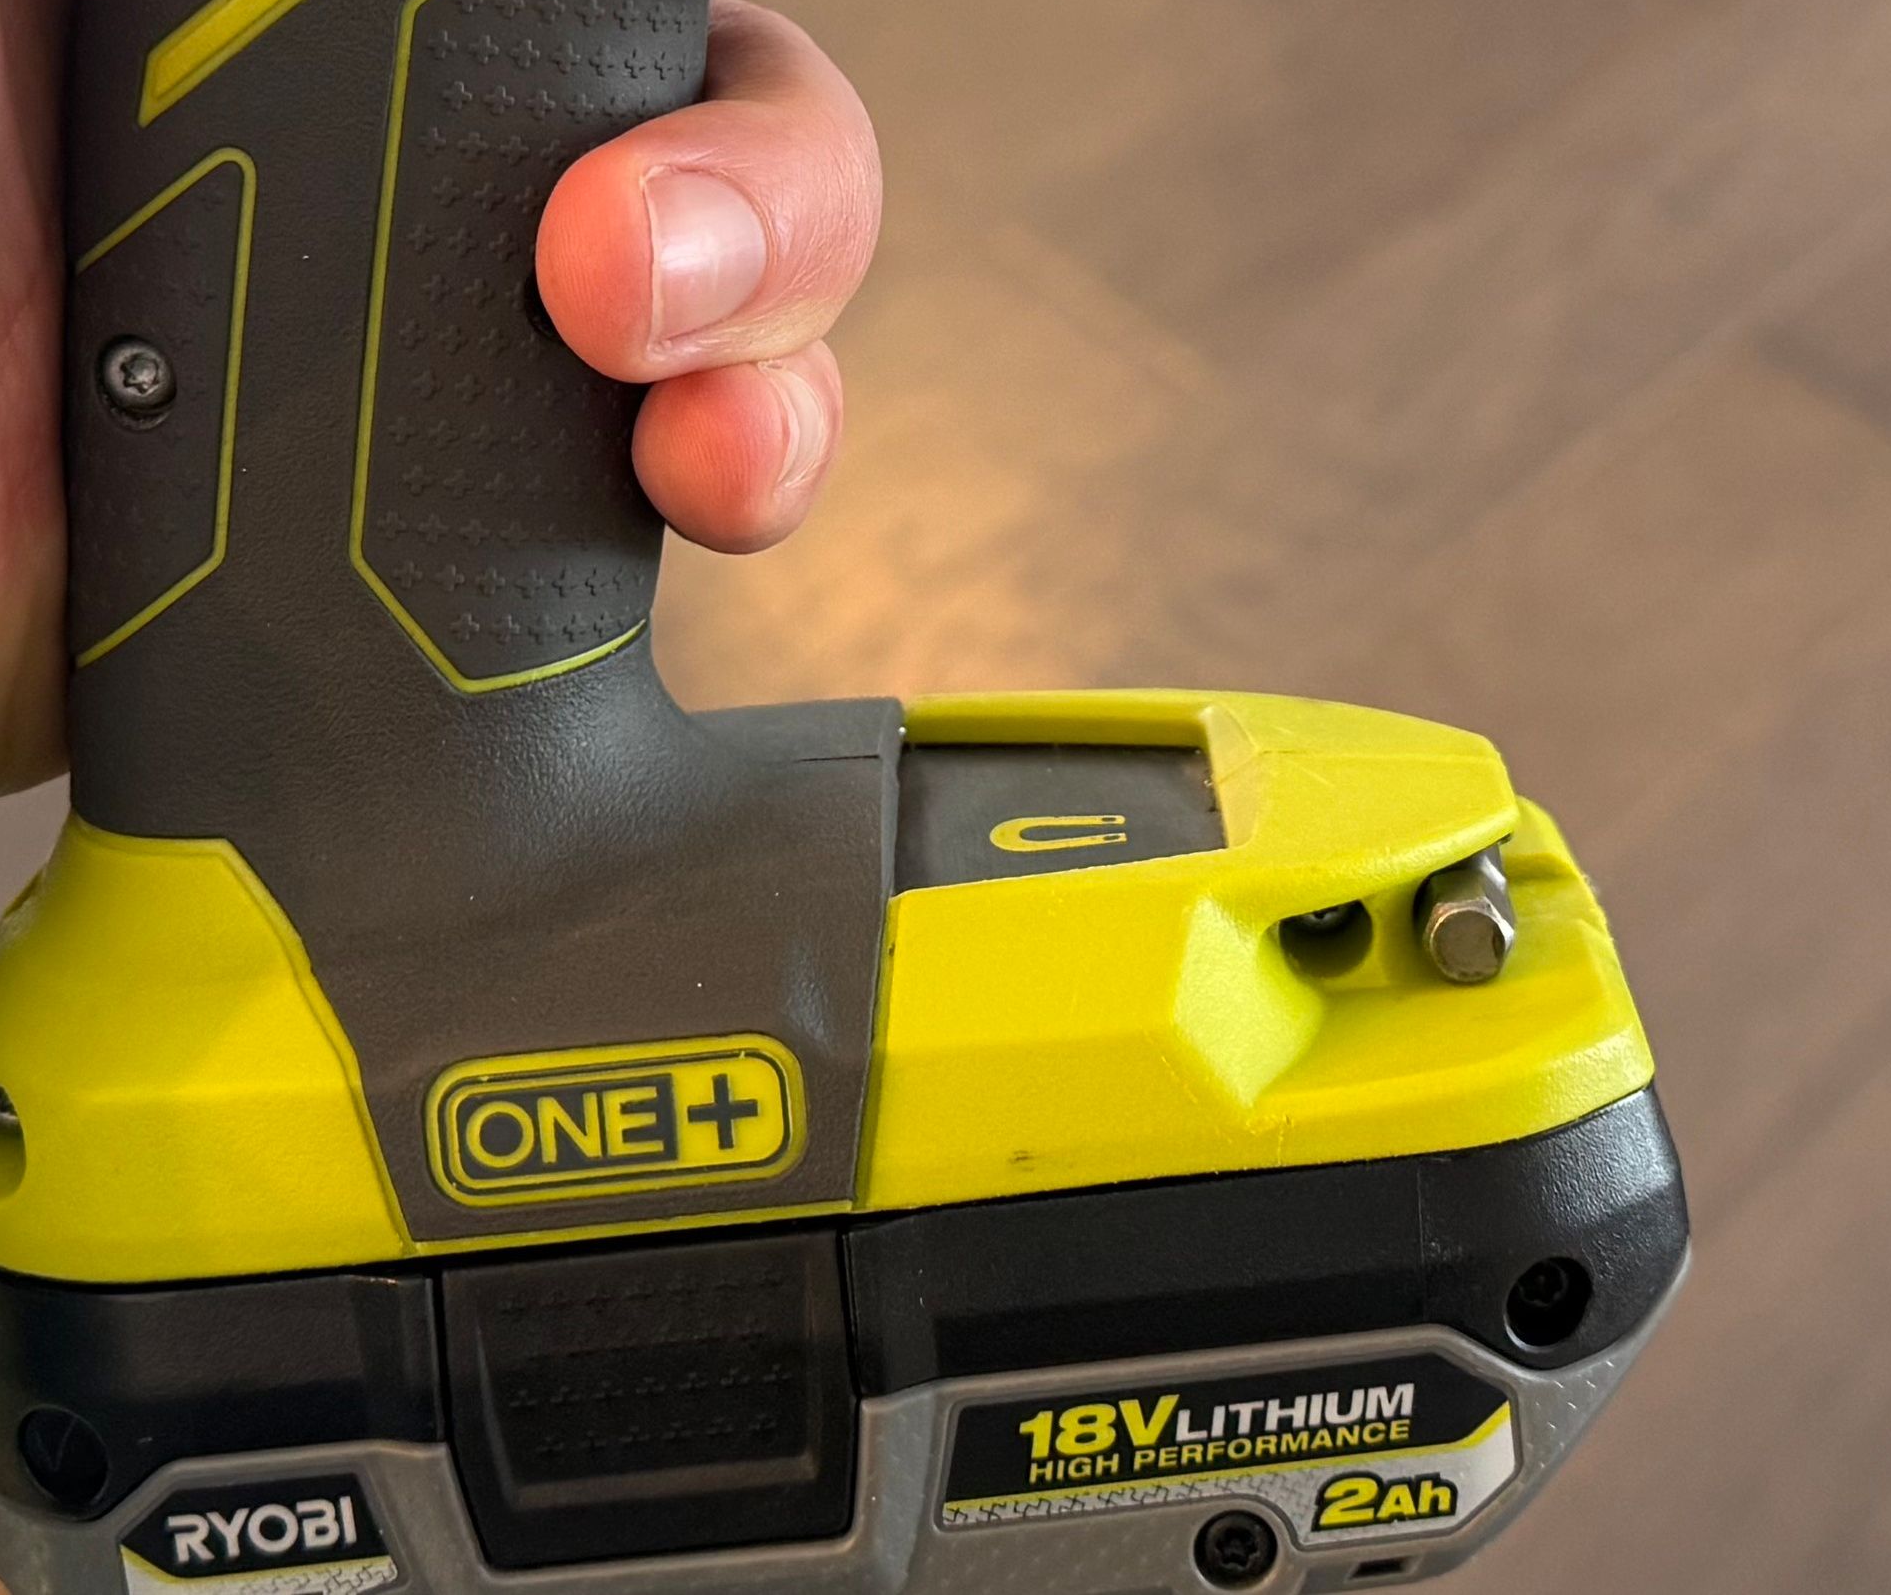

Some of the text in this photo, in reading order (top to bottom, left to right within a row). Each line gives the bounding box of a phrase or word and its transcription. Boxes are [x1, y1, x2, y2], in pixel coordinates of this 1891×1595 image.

[1019, 1383, 1415, 1460] 18V LITHIUM
[1029, 1418, 1411, 1485] HIGH PERFORMANCE
[167, 1495, 357, 1564] RYOBI
[1318, 1475, 1452, 1527] 2Ah
